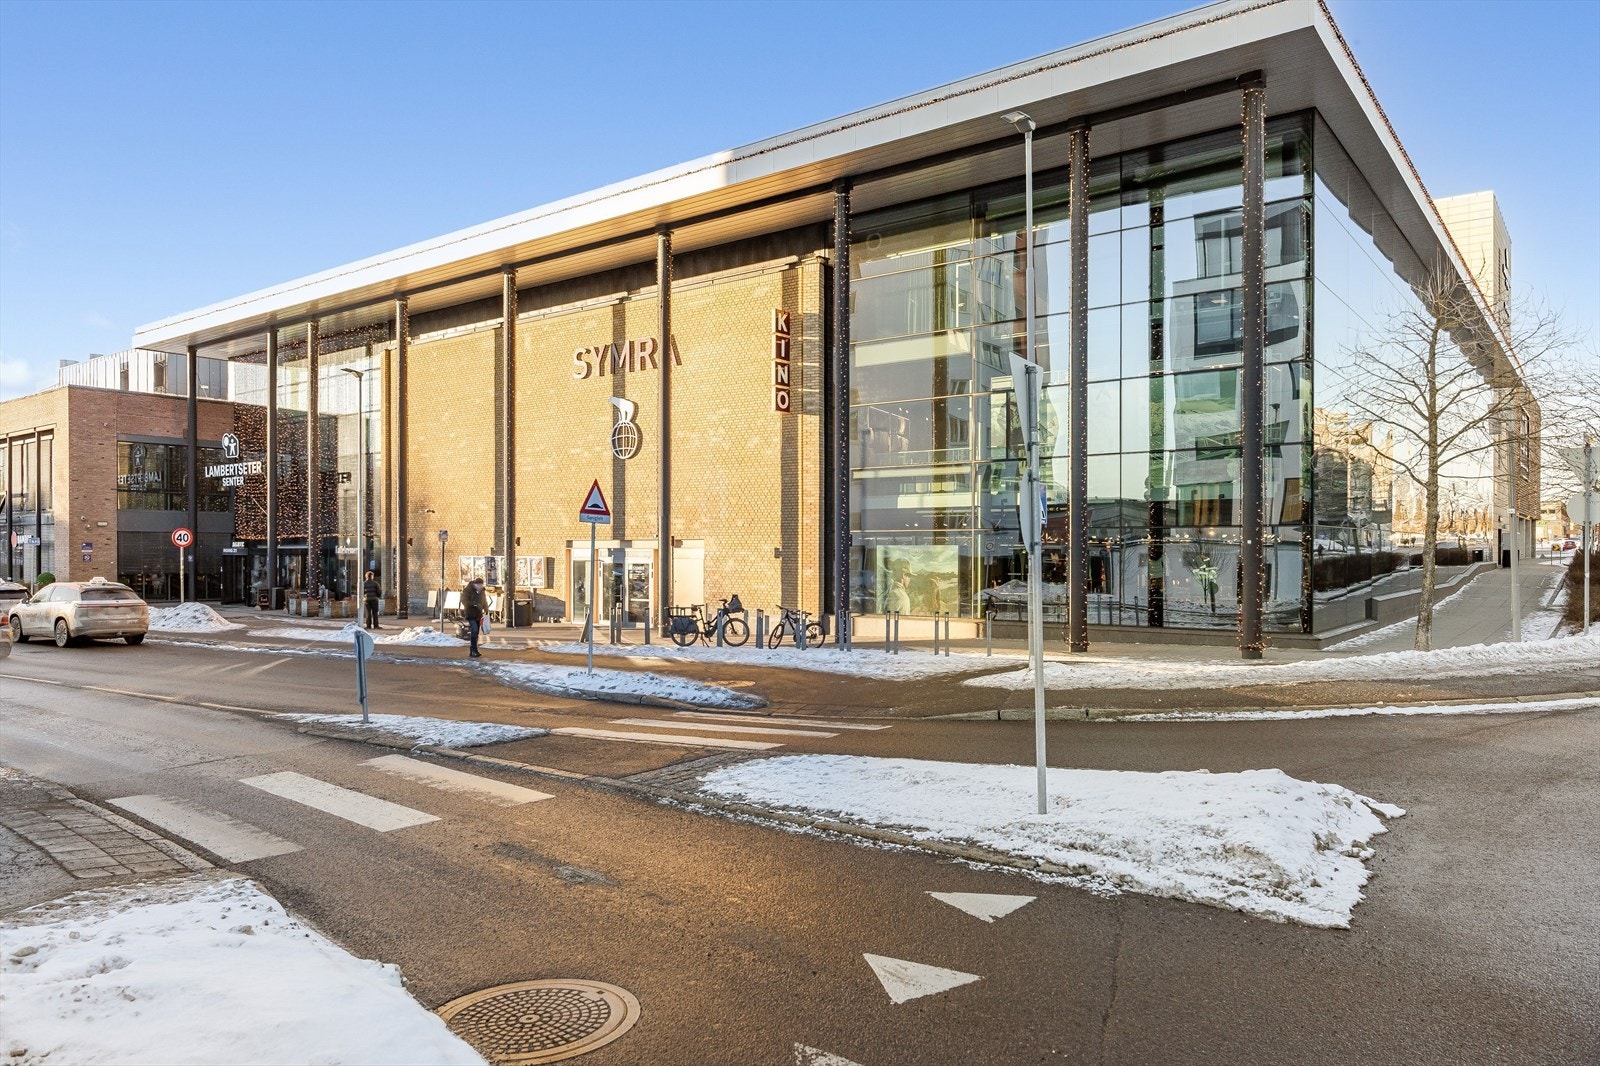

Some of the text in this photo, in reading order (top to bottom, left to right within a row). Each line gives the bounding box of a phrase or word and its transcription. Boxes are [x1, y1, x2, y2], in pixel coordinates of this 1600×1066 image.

[777, 312, 789, 410] KINO
[204, 461, 262, 478] LAMBERTSETER
[222, 476, 244, 487] SENTER
[176, 533, 189, 543] 40
